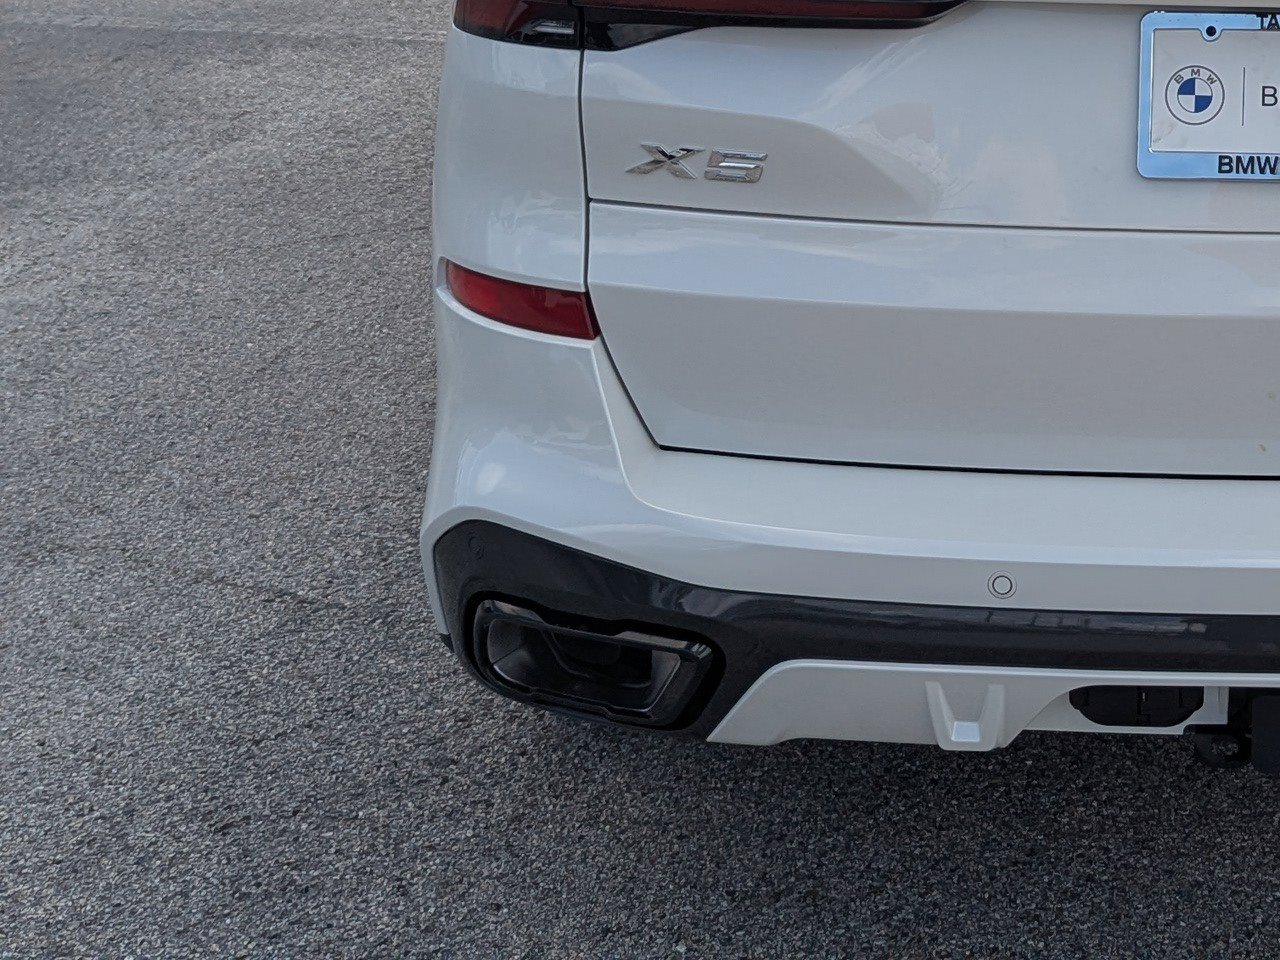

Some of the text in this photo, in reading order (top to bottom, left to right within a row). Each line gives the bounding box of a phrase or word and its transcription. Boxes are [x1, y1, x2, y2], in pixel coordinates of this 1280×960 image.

[1174, 68, 1218, 85] BMW
[625, 142, 768, 183] X5
[1217, 155, 1280, 174] BMW
